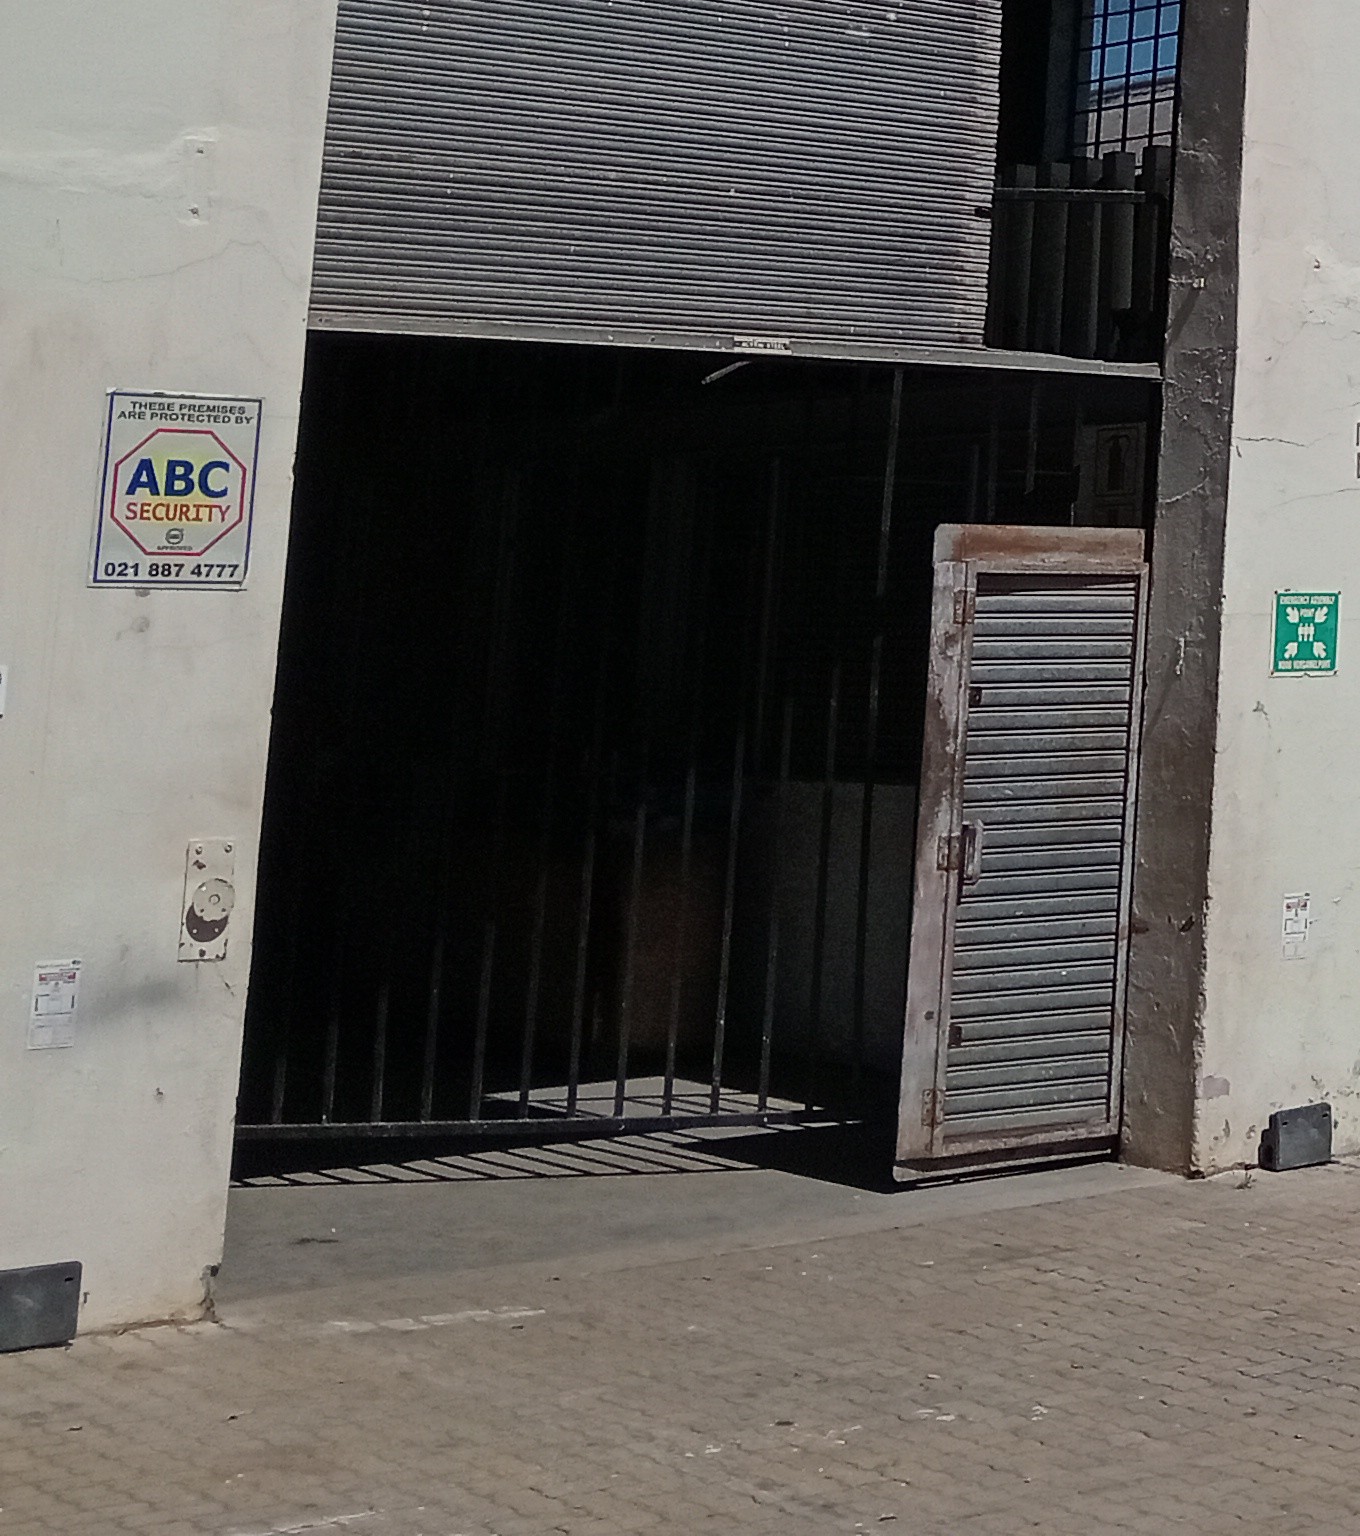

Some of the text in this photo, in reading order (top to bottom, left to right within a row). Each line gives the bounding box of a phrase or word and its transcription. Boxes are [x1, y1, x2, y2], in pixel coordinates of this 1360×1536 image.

[130, 401, 246, 415] THESE PREMISES
[117, 410, 254, 425] ARE PROTECTED BY
[125, 457, 230, 498] ABC
[125, 502, 231, 523] SECURITY
[104, 562, 239, 578] 021 887 4777
